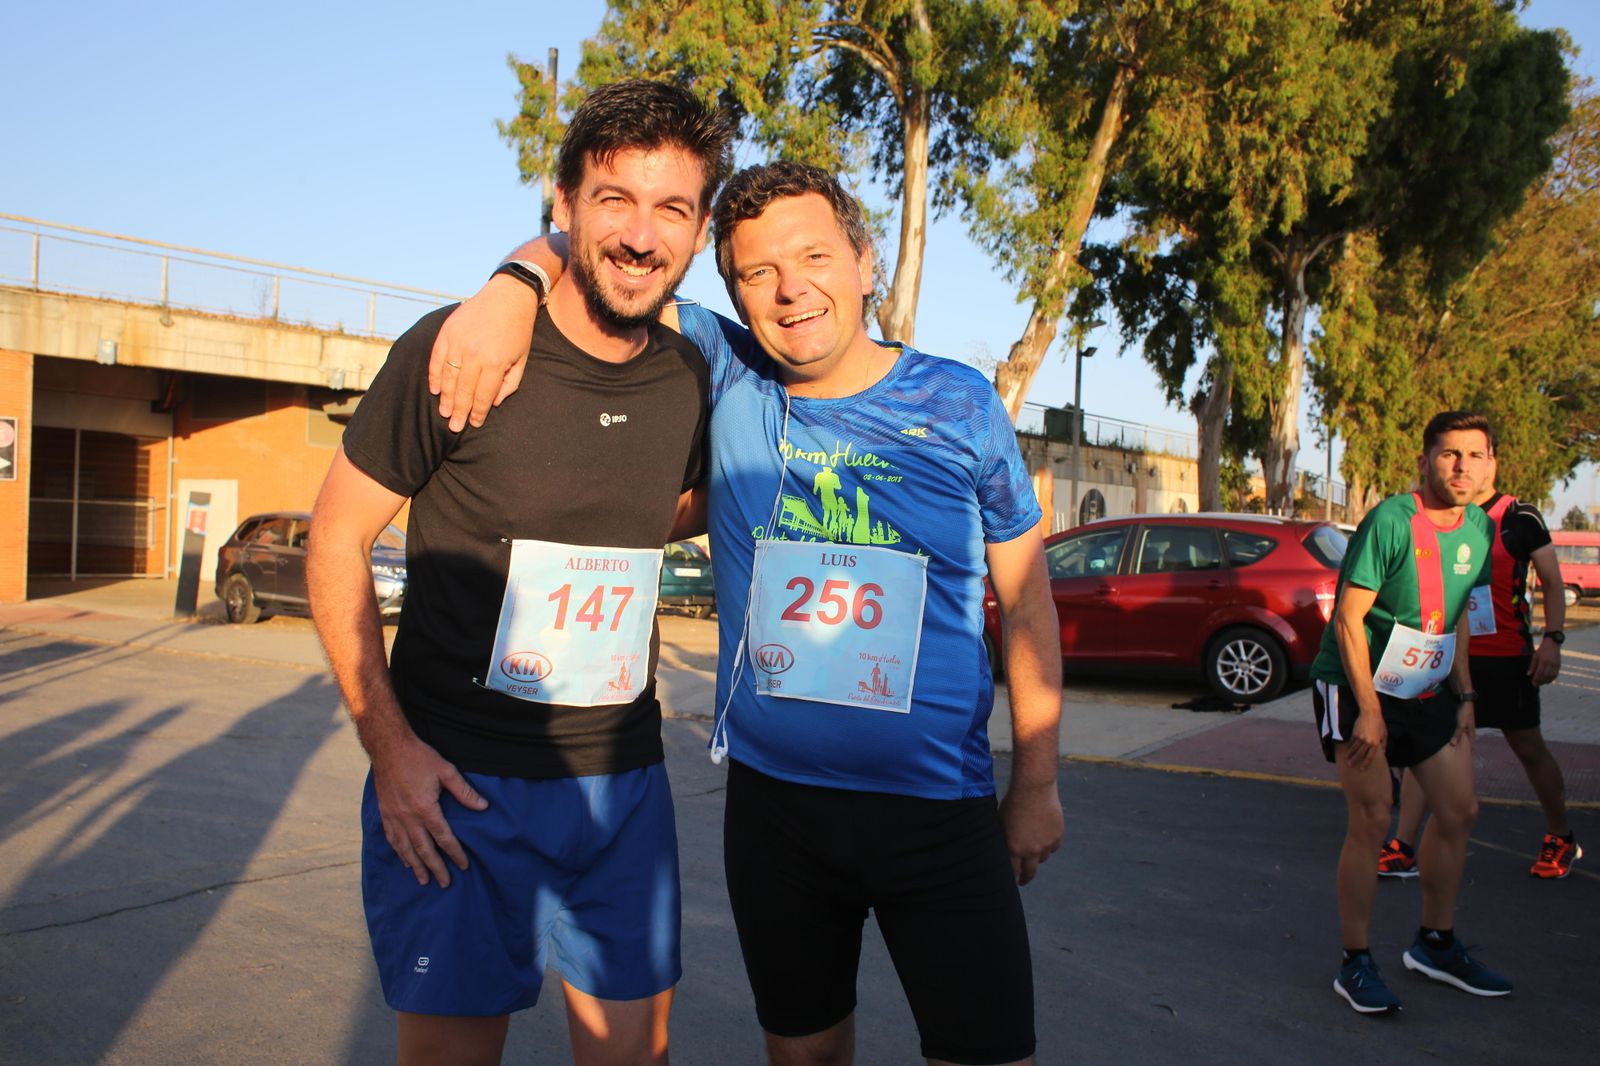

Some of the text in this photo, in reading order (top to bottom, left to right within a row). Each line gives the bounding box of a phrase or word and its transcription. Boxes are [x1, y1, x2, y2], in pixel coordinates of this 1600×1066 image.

[795, 447, 827, 466] km
[564, 556, 630, 573] ALBERTO
[820, 552, 857, 568] LUIS
[547, 583, 635, 632] 147
[780, 576, 885, 630] 256
[508, 658, 543, 677] KIA
[759, 651, 786, 669] KIA
[1403, 647, 1444, 669] 578
[506, 683, 539, 697] VEYSER
